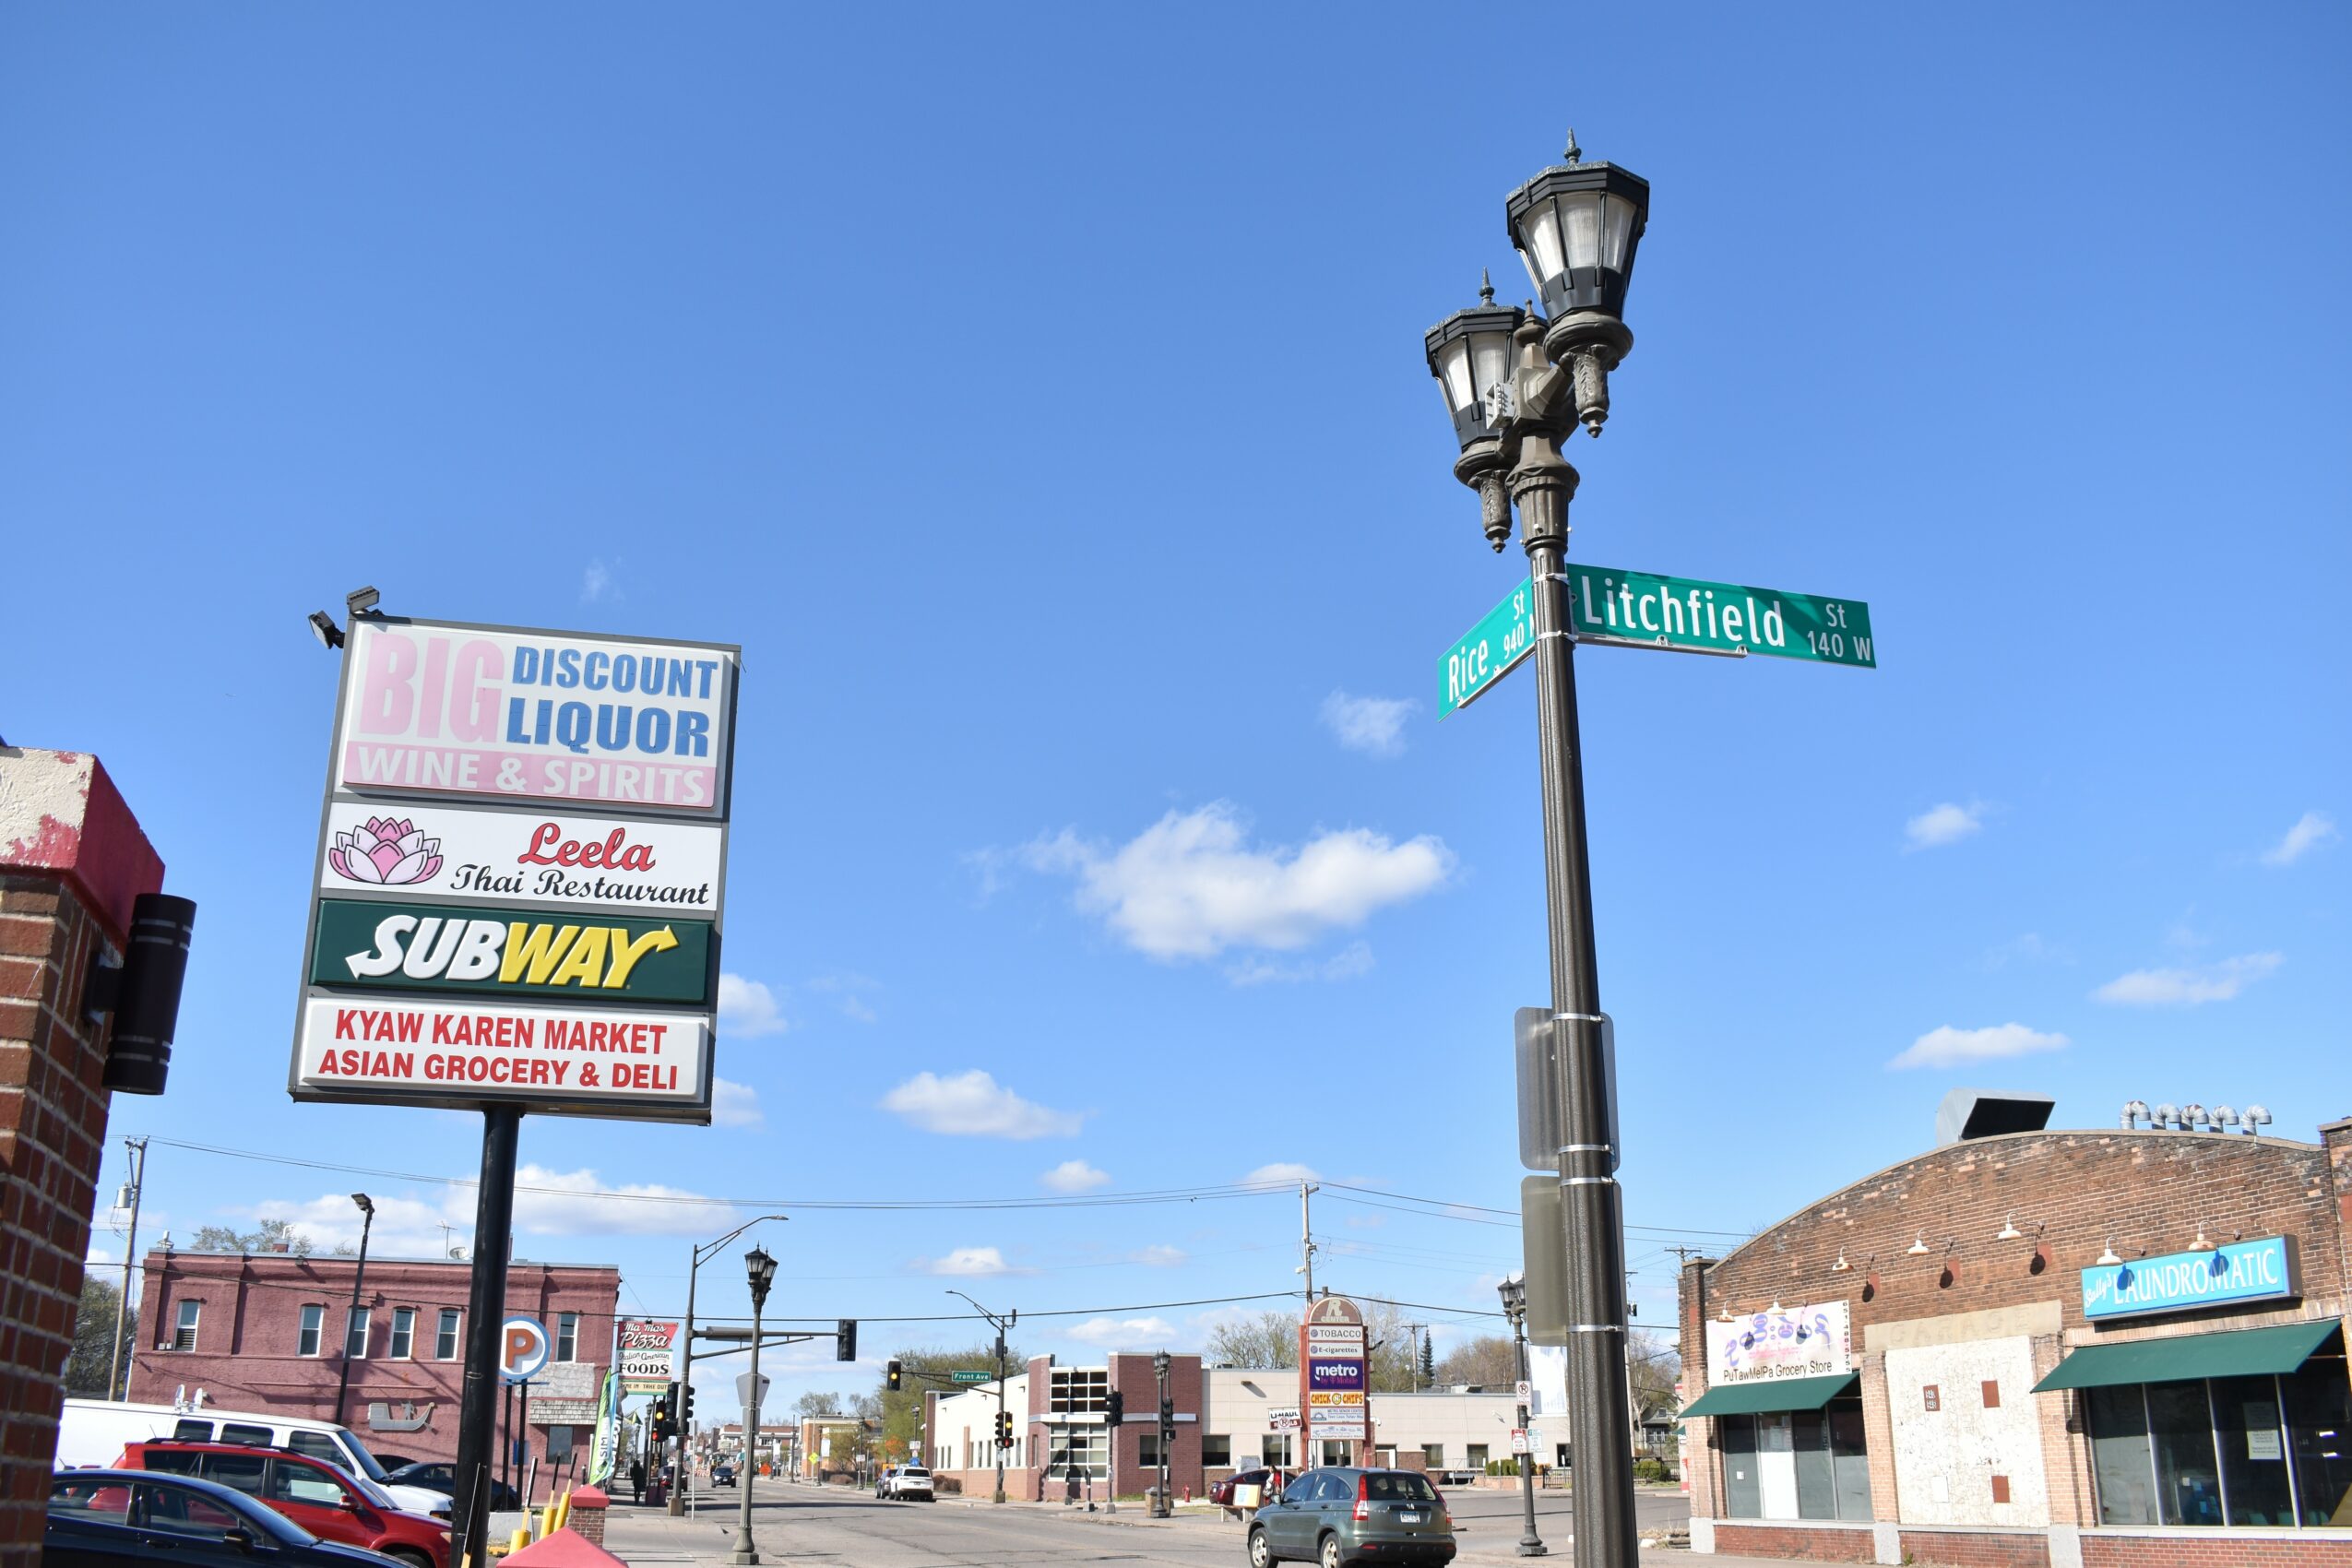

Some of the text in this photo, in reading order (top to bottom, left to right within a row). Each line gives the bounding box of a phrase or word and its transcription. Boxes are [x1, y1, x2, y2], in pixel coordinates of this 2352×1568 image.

[1581, 576, 1847, 647] Litchfield St
[1449, 590, 1524, 703] Rice St
[1503, 622, 1524, 659] 940
[1807, 630, 1871, 660] 140 W
[358, 632, 505, 743] BIG
[512, 646, 719, 699] DISCOUNT
[506, 697, 709, 757] LIQUOR
[358, 746, 705, 803] WINE & SPIRITS
[517, 822, 656, 872] Leela
[450, 864, 709, 905] Thai Restaurant
[345, 914, 679, 988] SUBWAY
[335, 1009, 667, 1054] KYAW KAREN MARKET
[318, 1049, 677, 1090] ASIAN GROCERY & DELI
[2113, 1248, 2278, 1304] LAUNDROMATIC
[620, 1331, 668, 1348] Pizza
[624, 1323, 640, 1332] Ma
[1319, 1329, 1361, 1337] TOBACCO
[619, 1363, 669, 1374] FOODS
[1314, 1364, 1358, 1377] metro
[1776, 1363, 1807, 1378] Grocery
[1810, 1360, 1832, 1373] Store
[1311, 1394, 1331, 1404] CHICK
[1342, 1394, 1363, 1404] CHIPS
